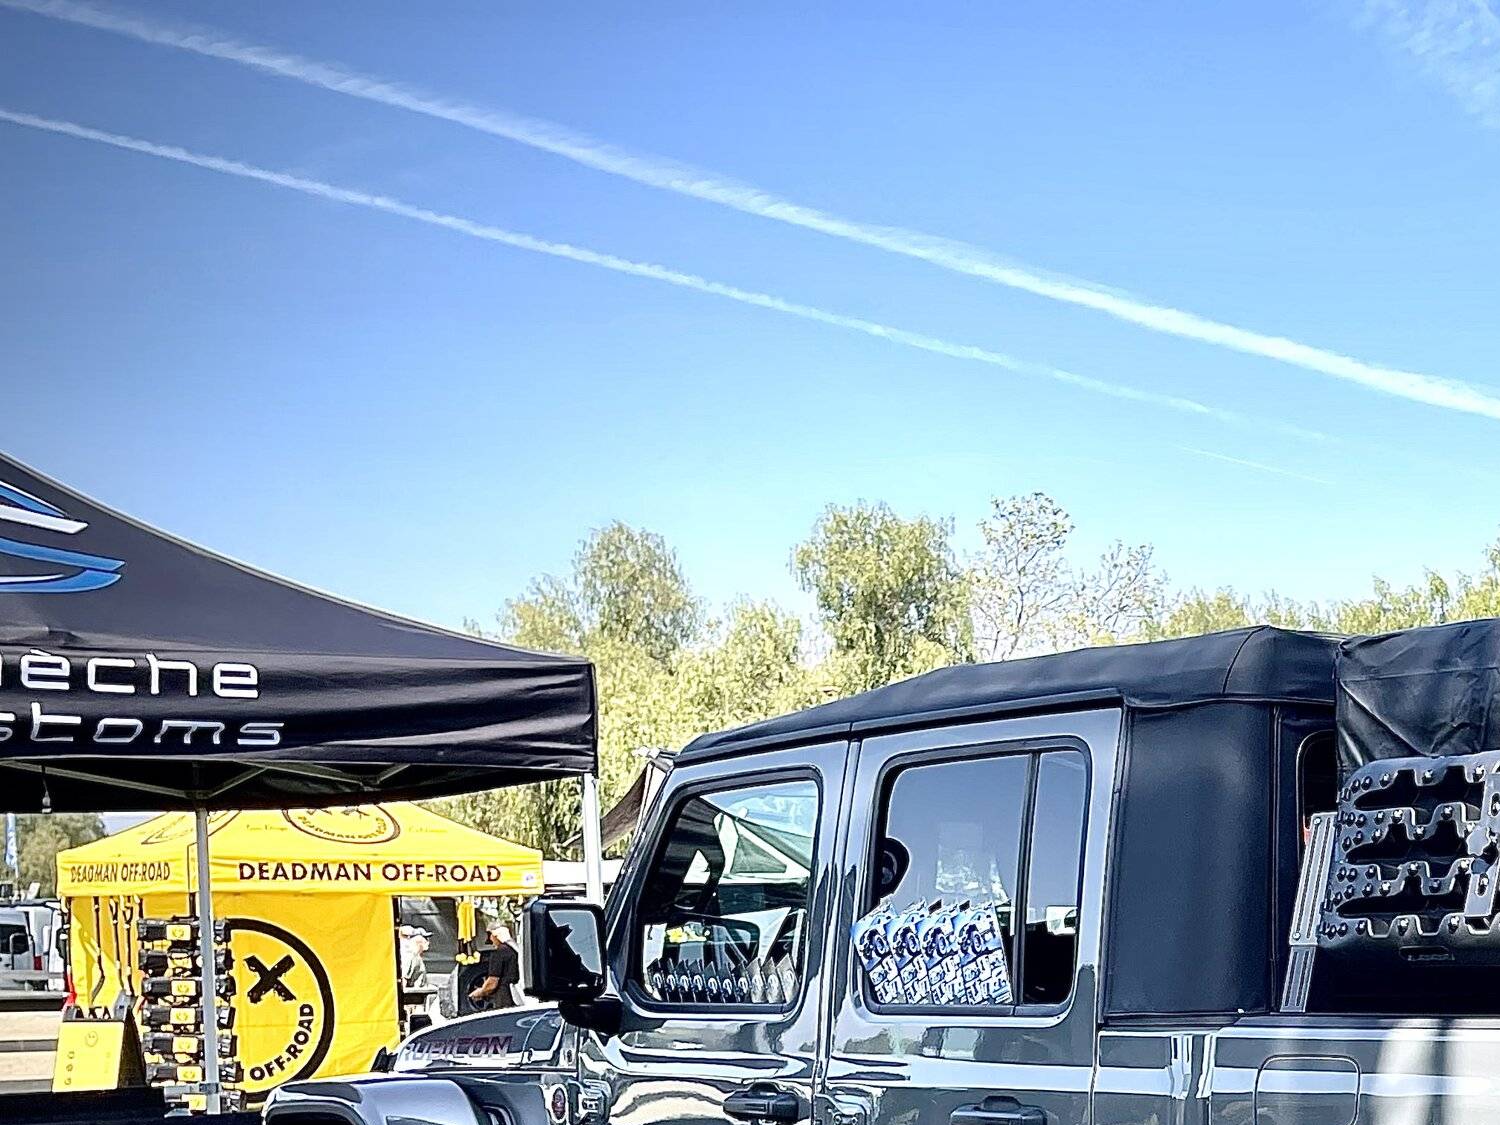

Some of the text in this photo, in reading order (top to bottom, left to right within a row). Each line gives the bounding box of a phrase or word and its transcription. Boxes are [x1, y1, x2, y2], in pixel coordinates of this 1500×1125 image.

[0, 648, 259, 699] èche
[70, 861, 171, 882] DEADMAN OFF-ROAD
[238, 862, 501, 883] DEADMAN OFF-ROAD
[249, 1003, 315, 1082] OFF-ROAD
[404, 1035, 513, 1061] RUBICON
